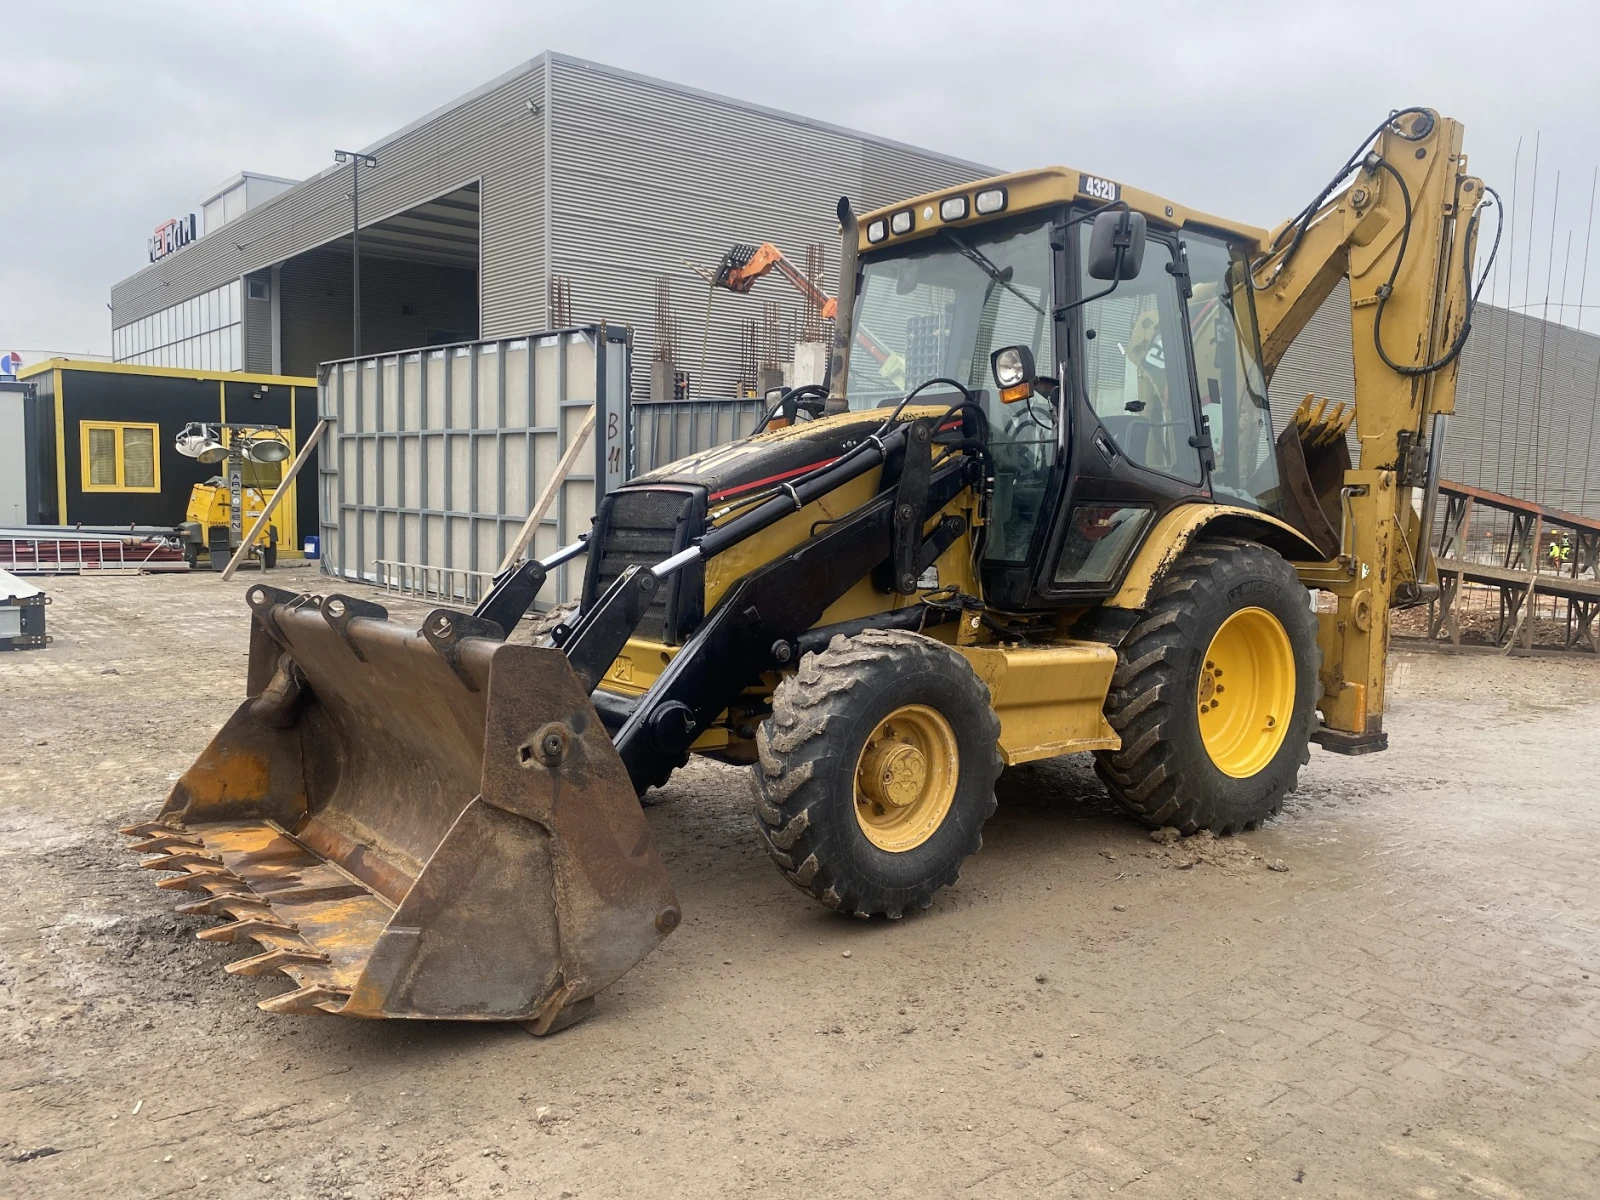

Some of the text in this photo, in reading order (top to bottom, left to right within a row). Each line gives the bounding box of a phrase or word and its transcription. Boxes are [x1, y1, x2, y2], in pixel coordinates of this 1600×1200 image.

[1086, 176, 1116, 201] 432D
[608, 412, 618, 440] B
[608, 446, 620, 474] 11
